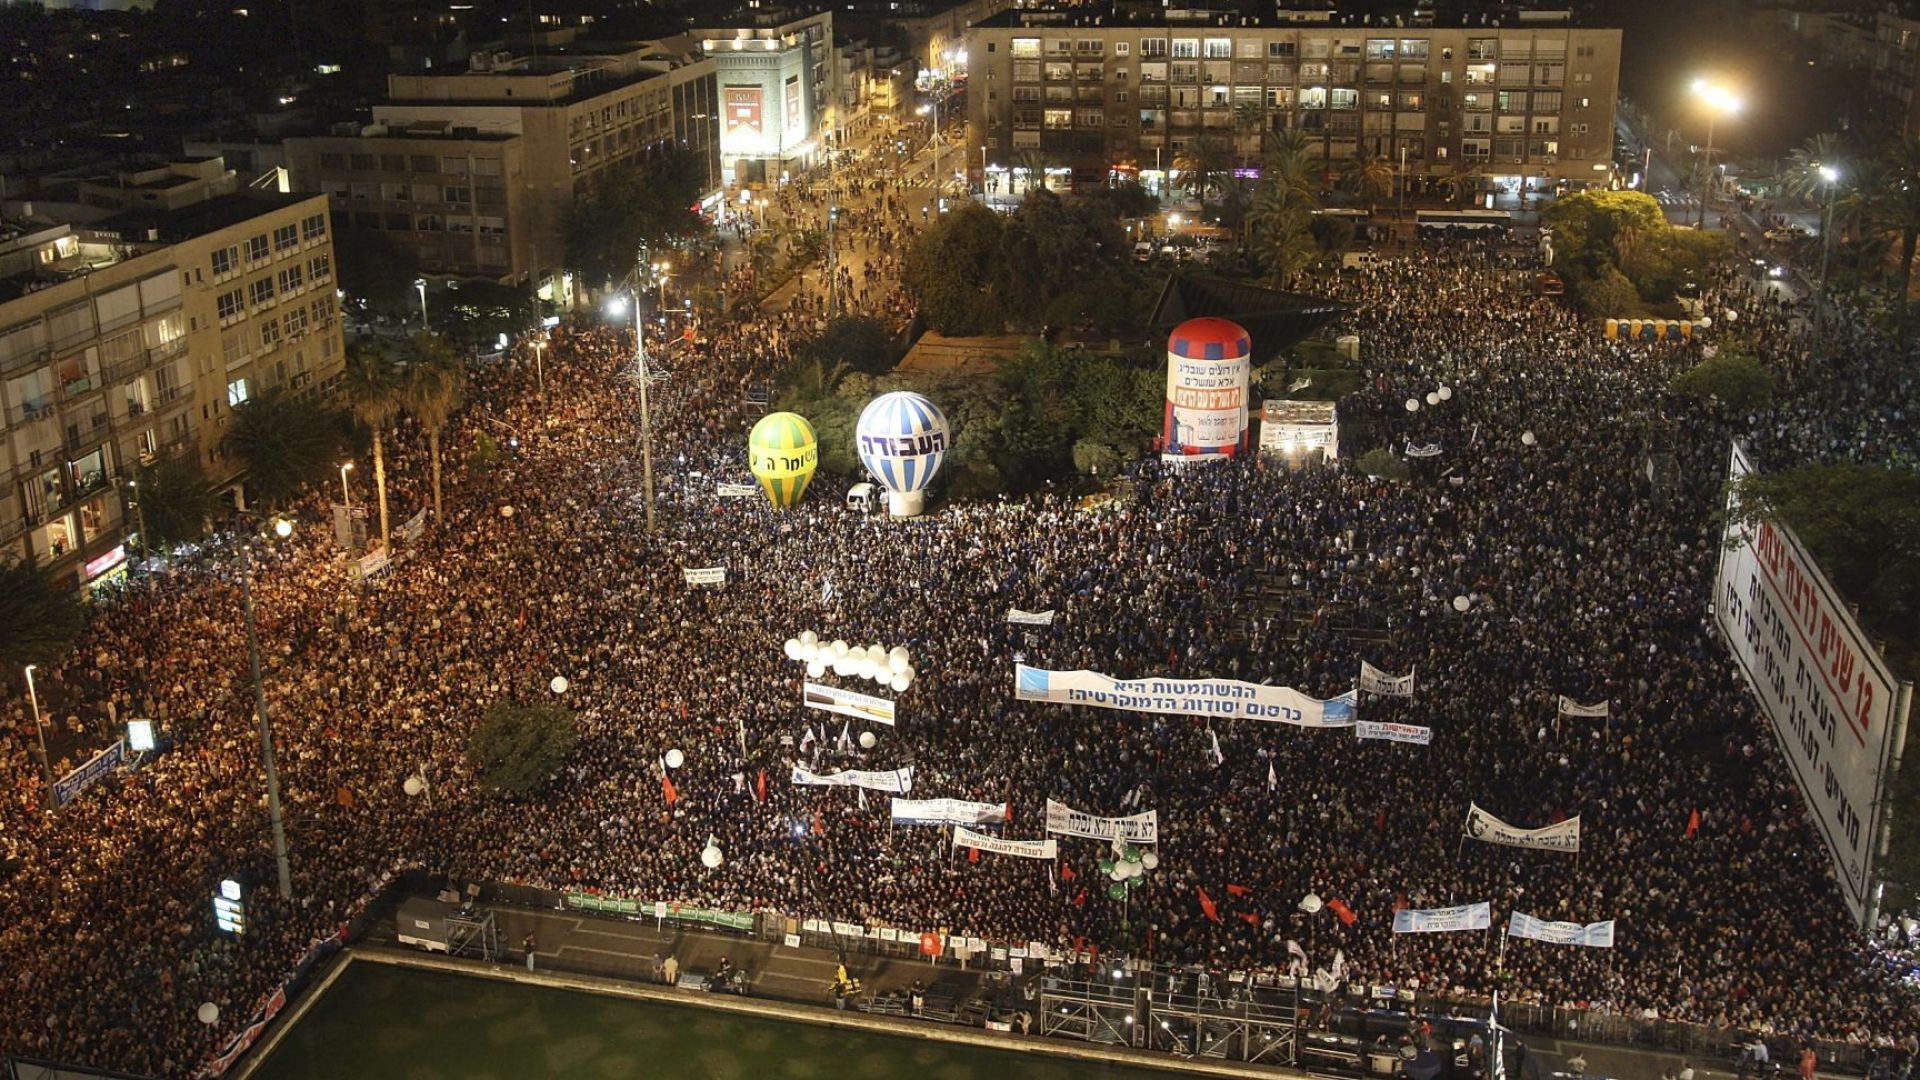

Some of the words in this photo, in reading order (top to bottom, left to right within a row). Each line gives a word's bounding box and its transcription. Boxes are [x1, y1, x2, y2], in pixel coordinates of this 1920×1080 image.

[861, 433, 944, 457] העבודה
[1726, 581, 1742, 626] רבין
[1786, 556, 1818, 637] לרצח
[1750, 573, 1791, 663] המרכזית
[1744, 609, 1761, 655] כיכר
[1819, 610, 1854, 694] שנים
[1764, 645, 1785, 704] 19:30
[1114, 682, 1146, 693] היא
[1152, 682, 1256, 699] ההשתמטות
[1069, 689, 1177, 710] הדמוקרטיה!
[1182, 699, 1240, 713] יסודות
[1796, 656, 1836, 748] העצרת
[1855, 671, 1873, 732] 12
[1246, 703, 1301, 720] כרסום
[1790, 696, 1819, 770] 3.11.07
[1069, 814, 1091, 833] נסלח
[1094, 819, 1111, 836] ולא
[1142, 814, 1154, 837] לא
[1538, 835, 1561, 846] נשכח
[1564, 830, 1577, 847] לא
